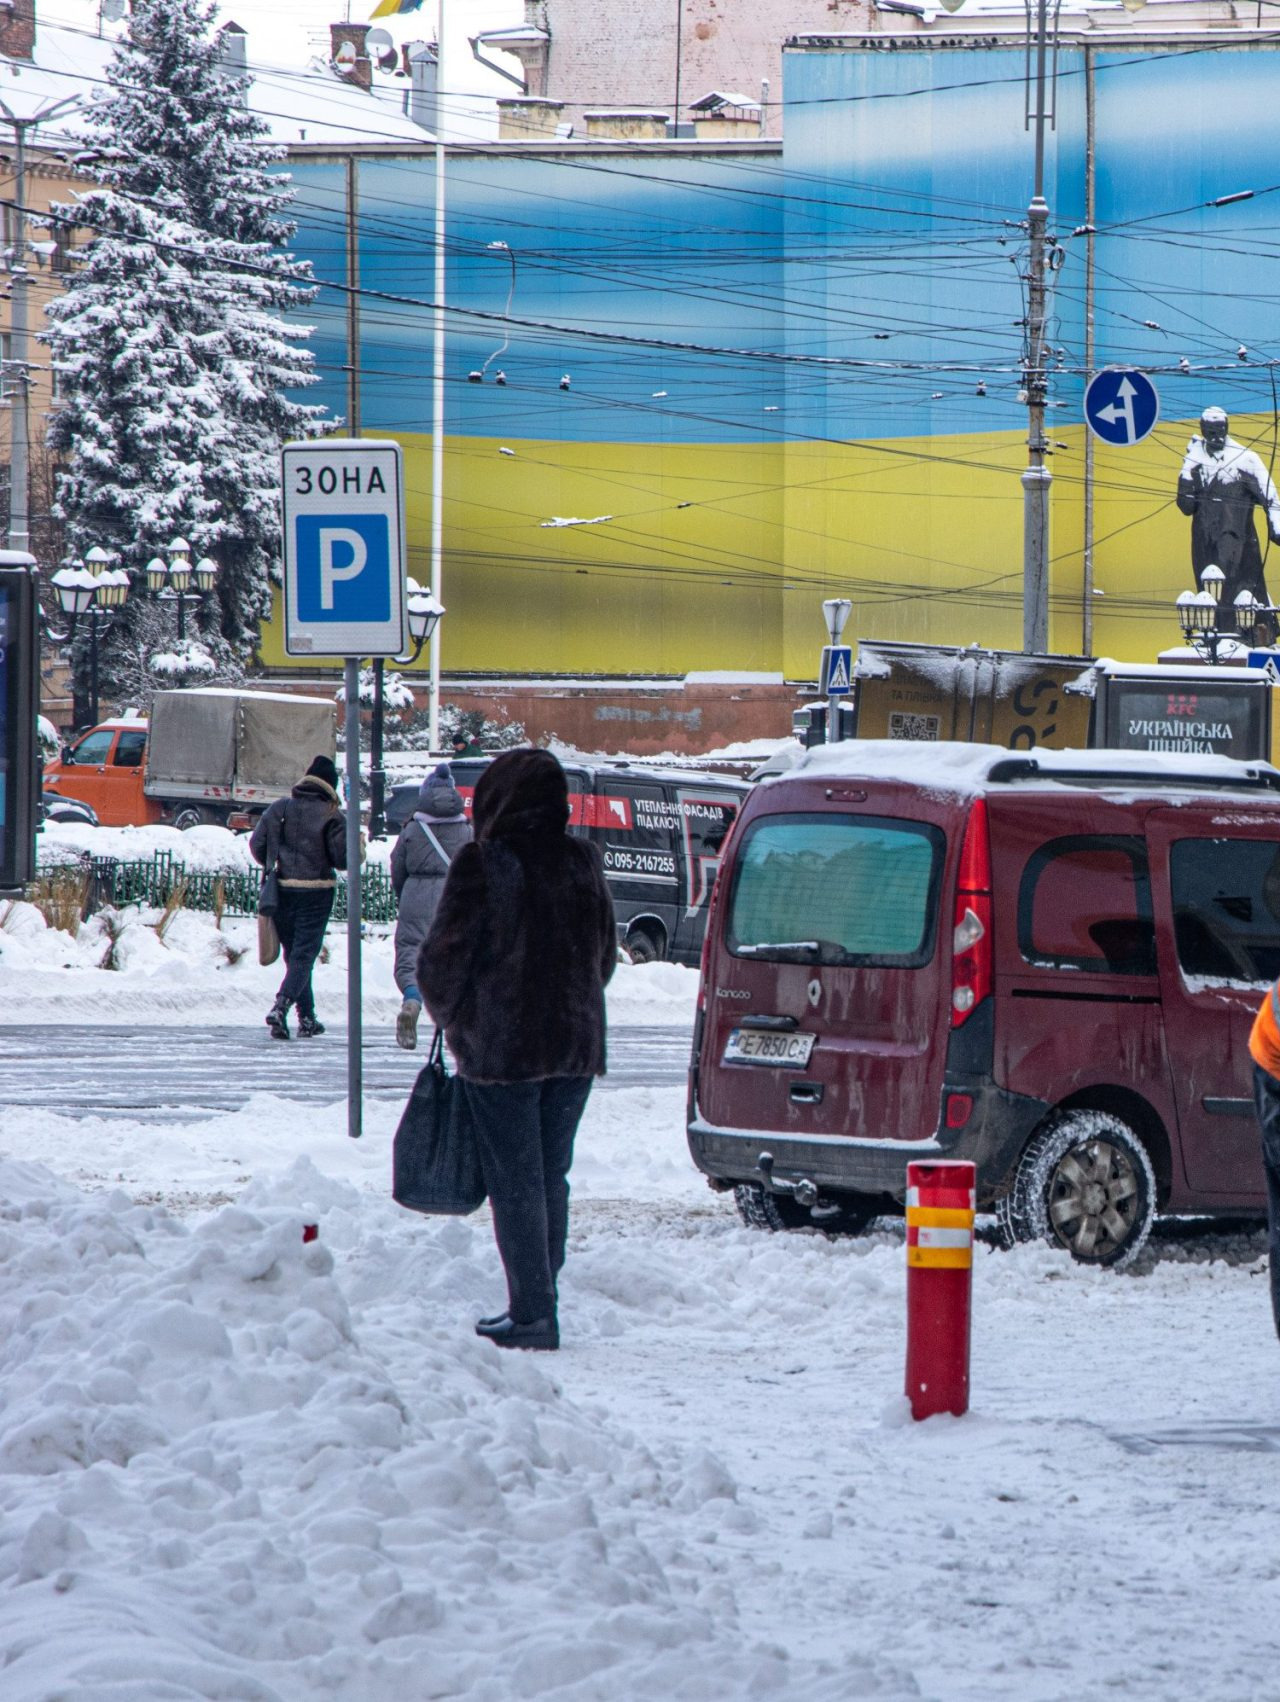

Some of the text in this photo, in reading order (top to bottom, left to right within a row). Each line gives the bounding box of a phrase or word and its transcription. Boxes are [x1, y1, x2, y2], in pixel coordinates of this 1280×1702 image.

[296, 466, 386, 494] ЗОНА
[319, 528, 367, 610] P
[1167, 704, 1196, 715] KFC
[1128, 719, 1233, 739] УКРАЇНСЬКА
[684, 803, 724, 820] ФАСАДІВ
[615, 852, 675, 873] 095-2167255
[755, 1035, 787, 1057] 7850
